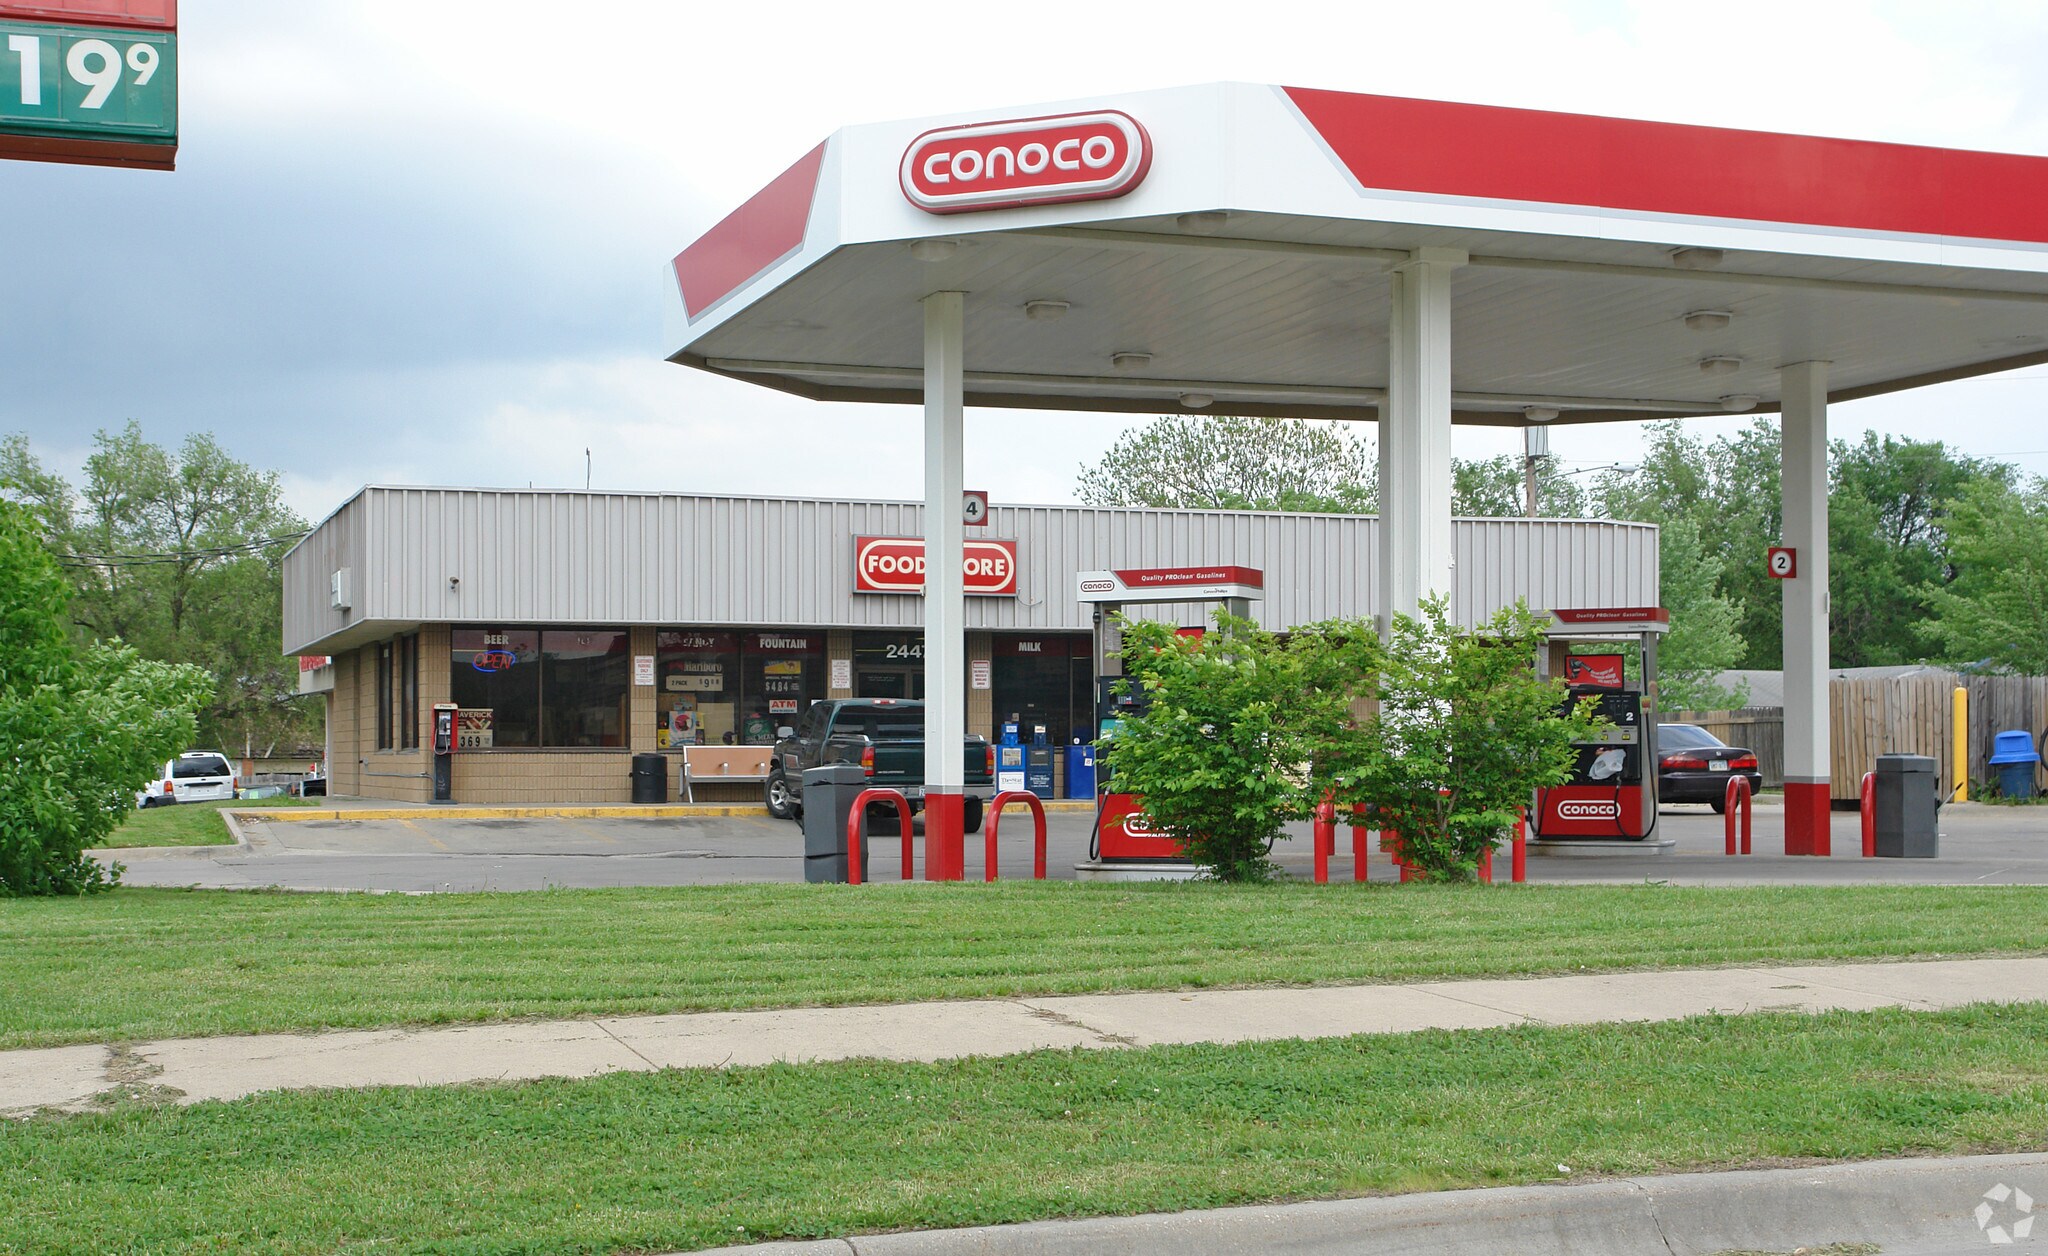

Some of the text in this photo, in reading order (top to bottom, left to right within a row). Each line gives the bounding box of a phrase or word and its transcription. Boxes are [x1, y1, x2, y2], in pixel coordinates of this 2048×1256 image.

[966, 501, 978, 515] 4
[868, 555, 1006, 577] FOOD ORE
[1777, 556, 1786, 569] 2
[1141, 574, 1164, 582] Quality
[483, 634, 509, 645] BEER
[760, 638, 807, 649] FOUNTAIN
[1018, 641, 1041, 652] MILK
[473, 652, 513, 670] OPEN
[771, 700, 796, 708] ATM
[1625, 712, 1634, 721] 2
